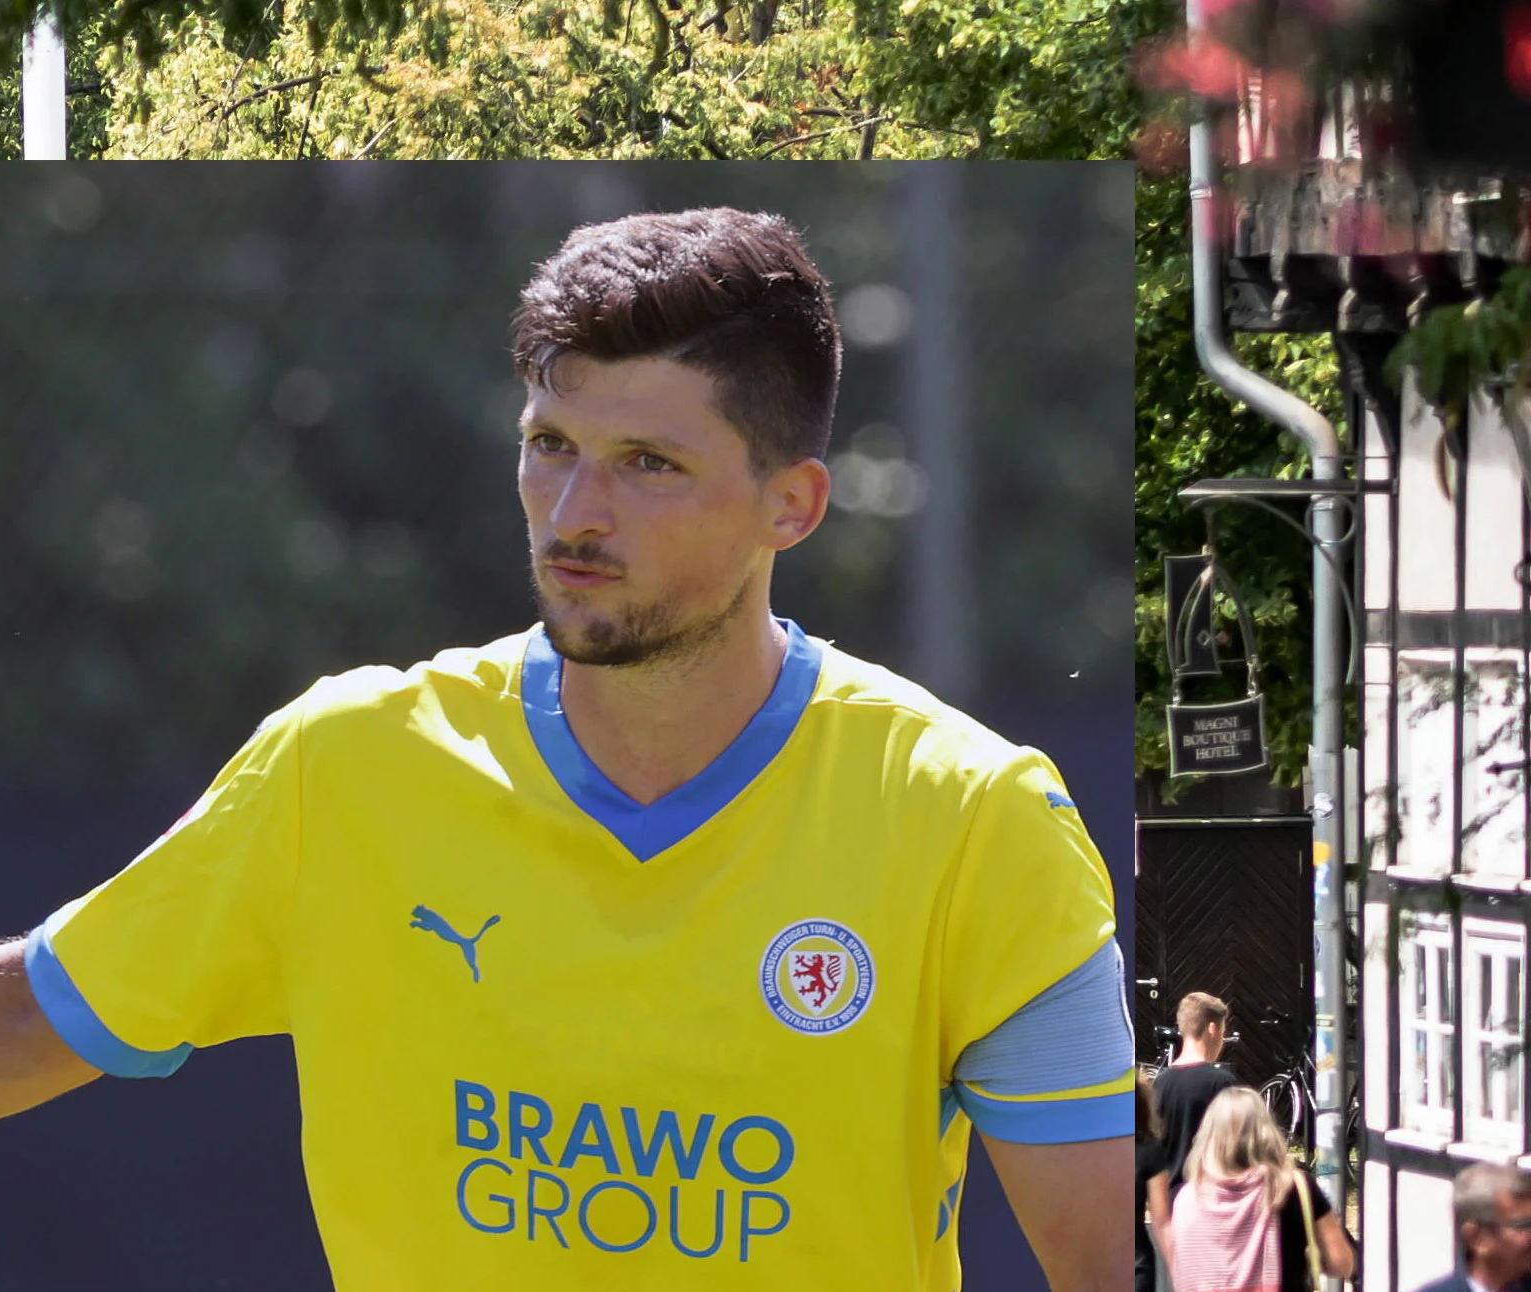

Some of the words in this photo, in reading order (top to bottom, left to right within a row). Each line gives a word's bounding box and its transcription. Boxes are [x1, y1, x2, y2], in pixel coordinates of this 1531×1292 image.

[1193, 716, 1238, 731] MAGNI
[1182, 729, 1252, 747] BOUTIQUE
[1195, 745, 1242, 760] HOTEL
[454, 1079, 795, 1185] BRAWO
[456, 1157, 791, 1262] GROUP
